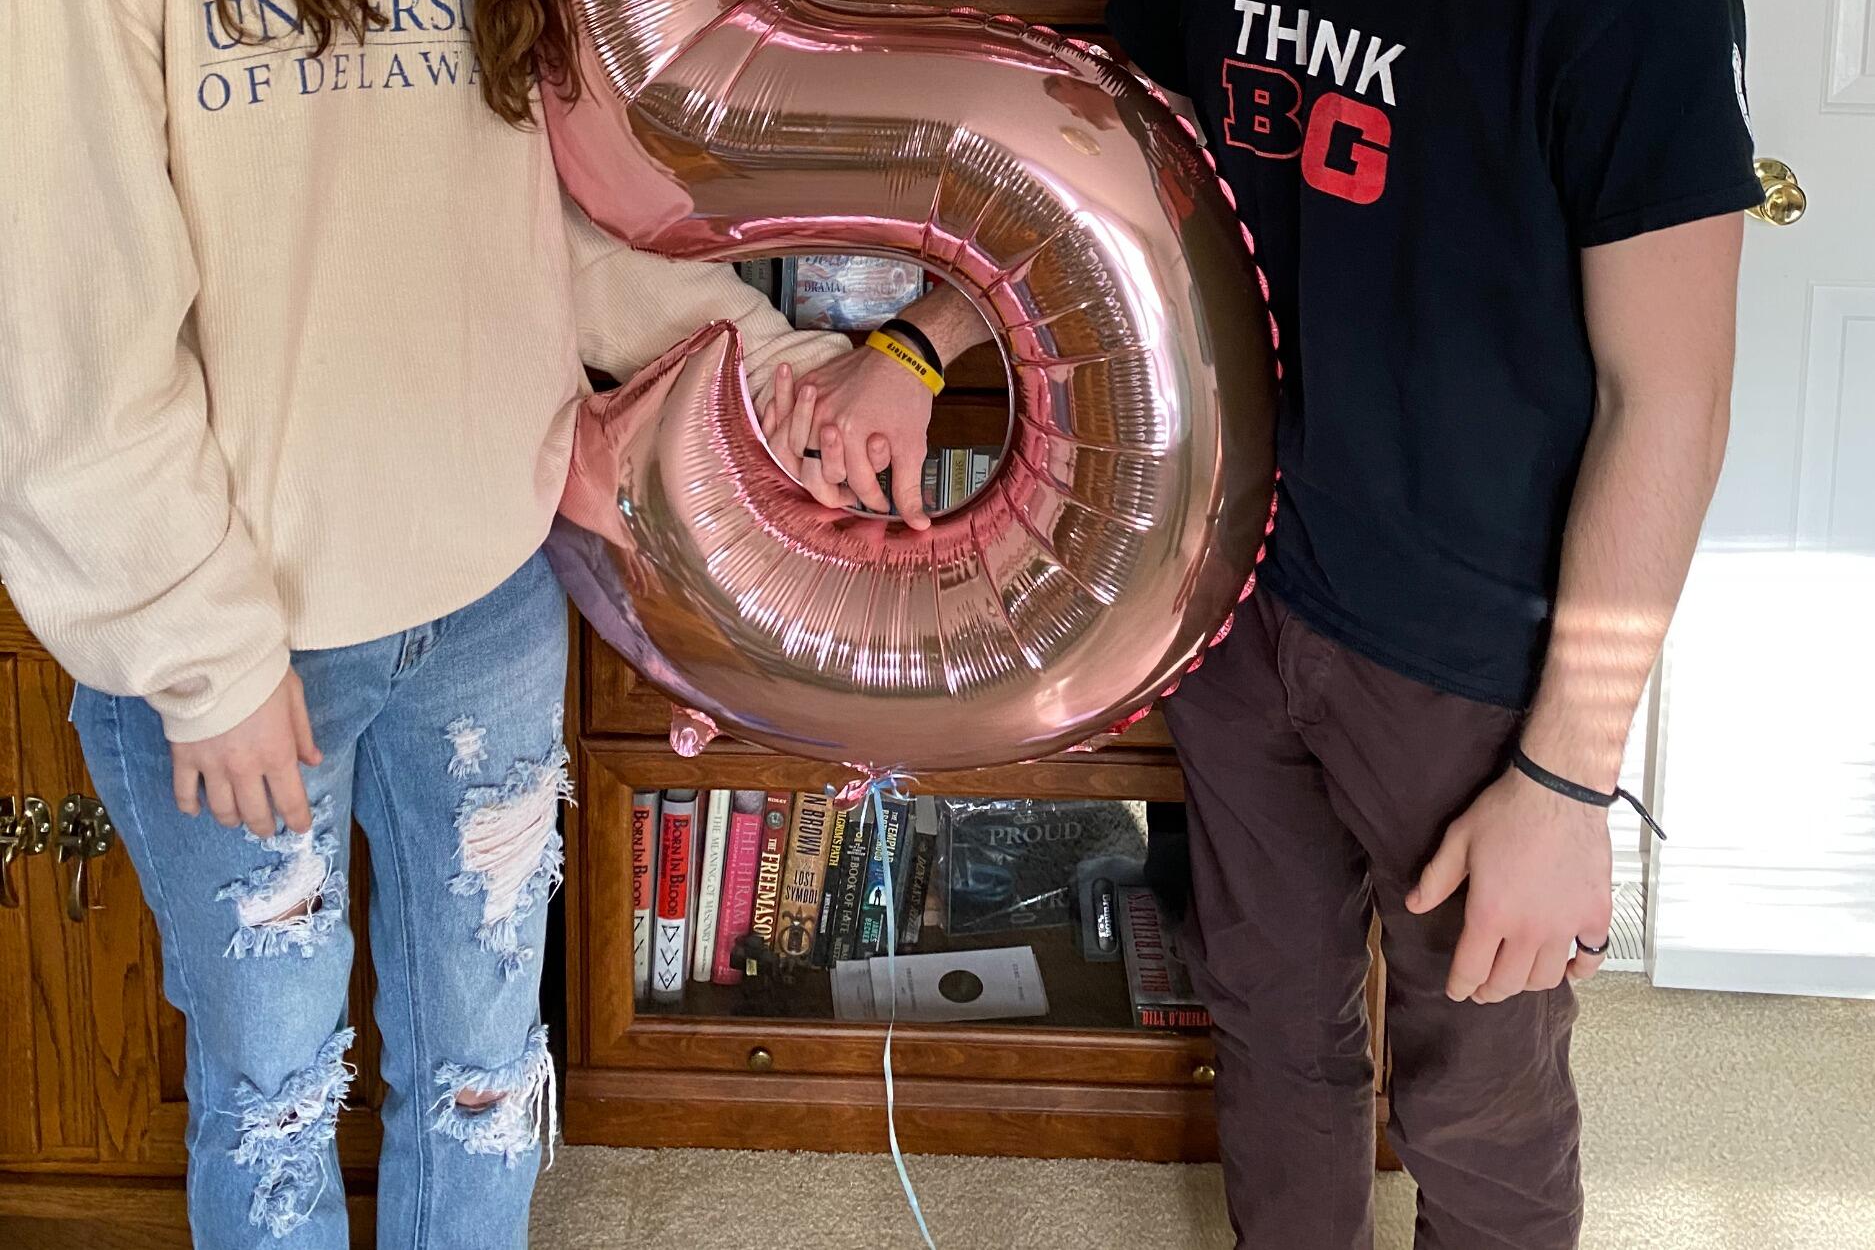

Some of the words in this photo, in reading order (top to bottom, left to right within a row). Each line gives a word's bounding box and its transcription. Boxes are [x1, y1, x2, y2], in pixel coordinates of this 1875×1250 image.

[197, 64, 272, 111] OF
[295, 50, 481, 95] DELAW
[1222, 57, 1392, 204] BG
[670, 819, 689, 856] BORN
[711, 816, 723, 834] THE
[740, 822, 758, 855] THE
[796, 808, 826, 857] BROWN
[833, 810, 848, 846] ILGRIM'S
[987, 821, 1082, 846] PROUD
[633, 848, 646, 864] IN
[707, 837, 720, 882] MEANING
[767, 838, 778, 852] THE
[828, 845, 841, 867] PATH
[670, 857, 684, 870] IN
[846, 862, 860, 891] BOOK
[706, 884, 716, 896] OF
[793, 870, 815, 887] LOST
[667, 874, 686, 916] BLOOD
[733, 862, 753, 925] HIRAM
[753, 851, 781, 944] FREEMASO
[786, 886, 818, 904] SYMBOL
[843, 893, 855, 908] OF
[702, 900, 714, 942] MASONRY
[1142, 1009, 1165, 1026] BILL
